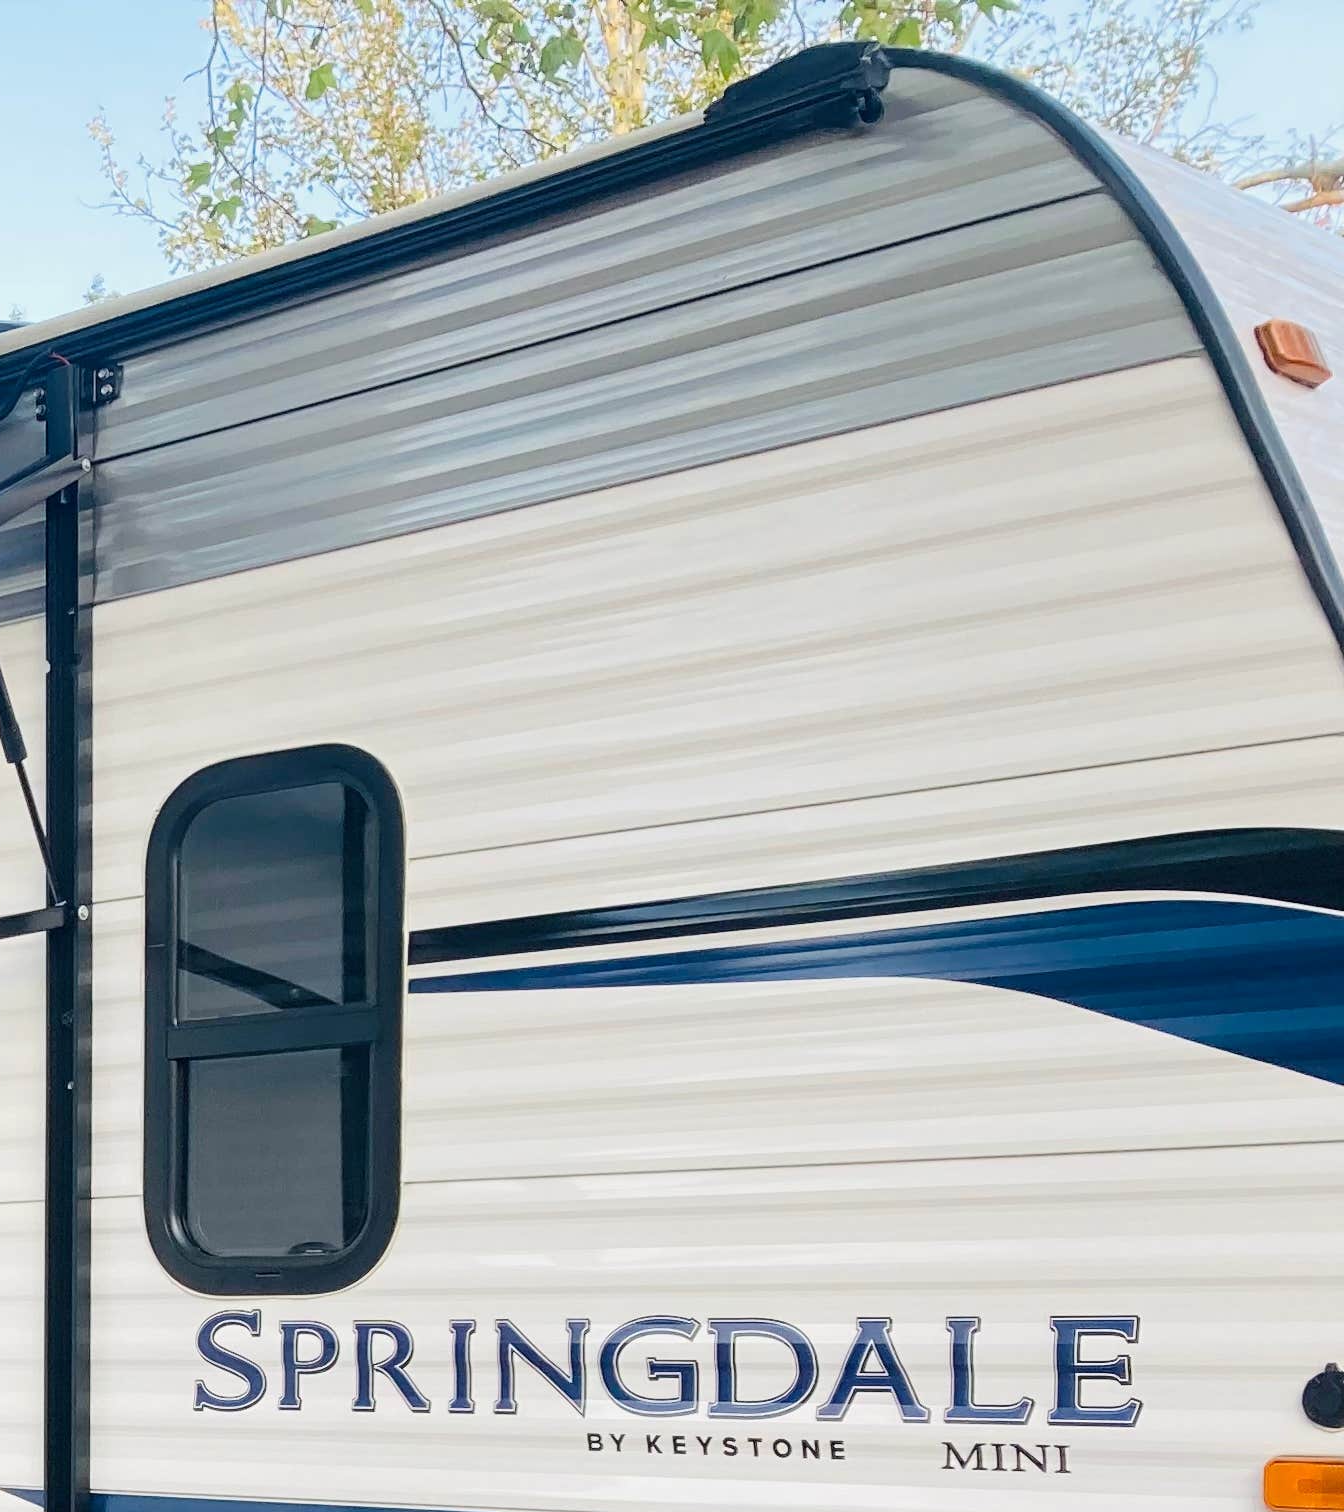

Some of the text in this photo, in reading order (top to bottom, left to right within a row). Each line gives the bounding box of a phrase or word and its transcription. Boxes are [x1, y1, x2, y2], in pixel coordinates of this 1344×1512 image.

[193, 1308, 1142, 1428] SPRINGDALE
[587, 1433, 846, 1460] BY KEYSTONE
[941, 1441, 1071, 1474] MINI
